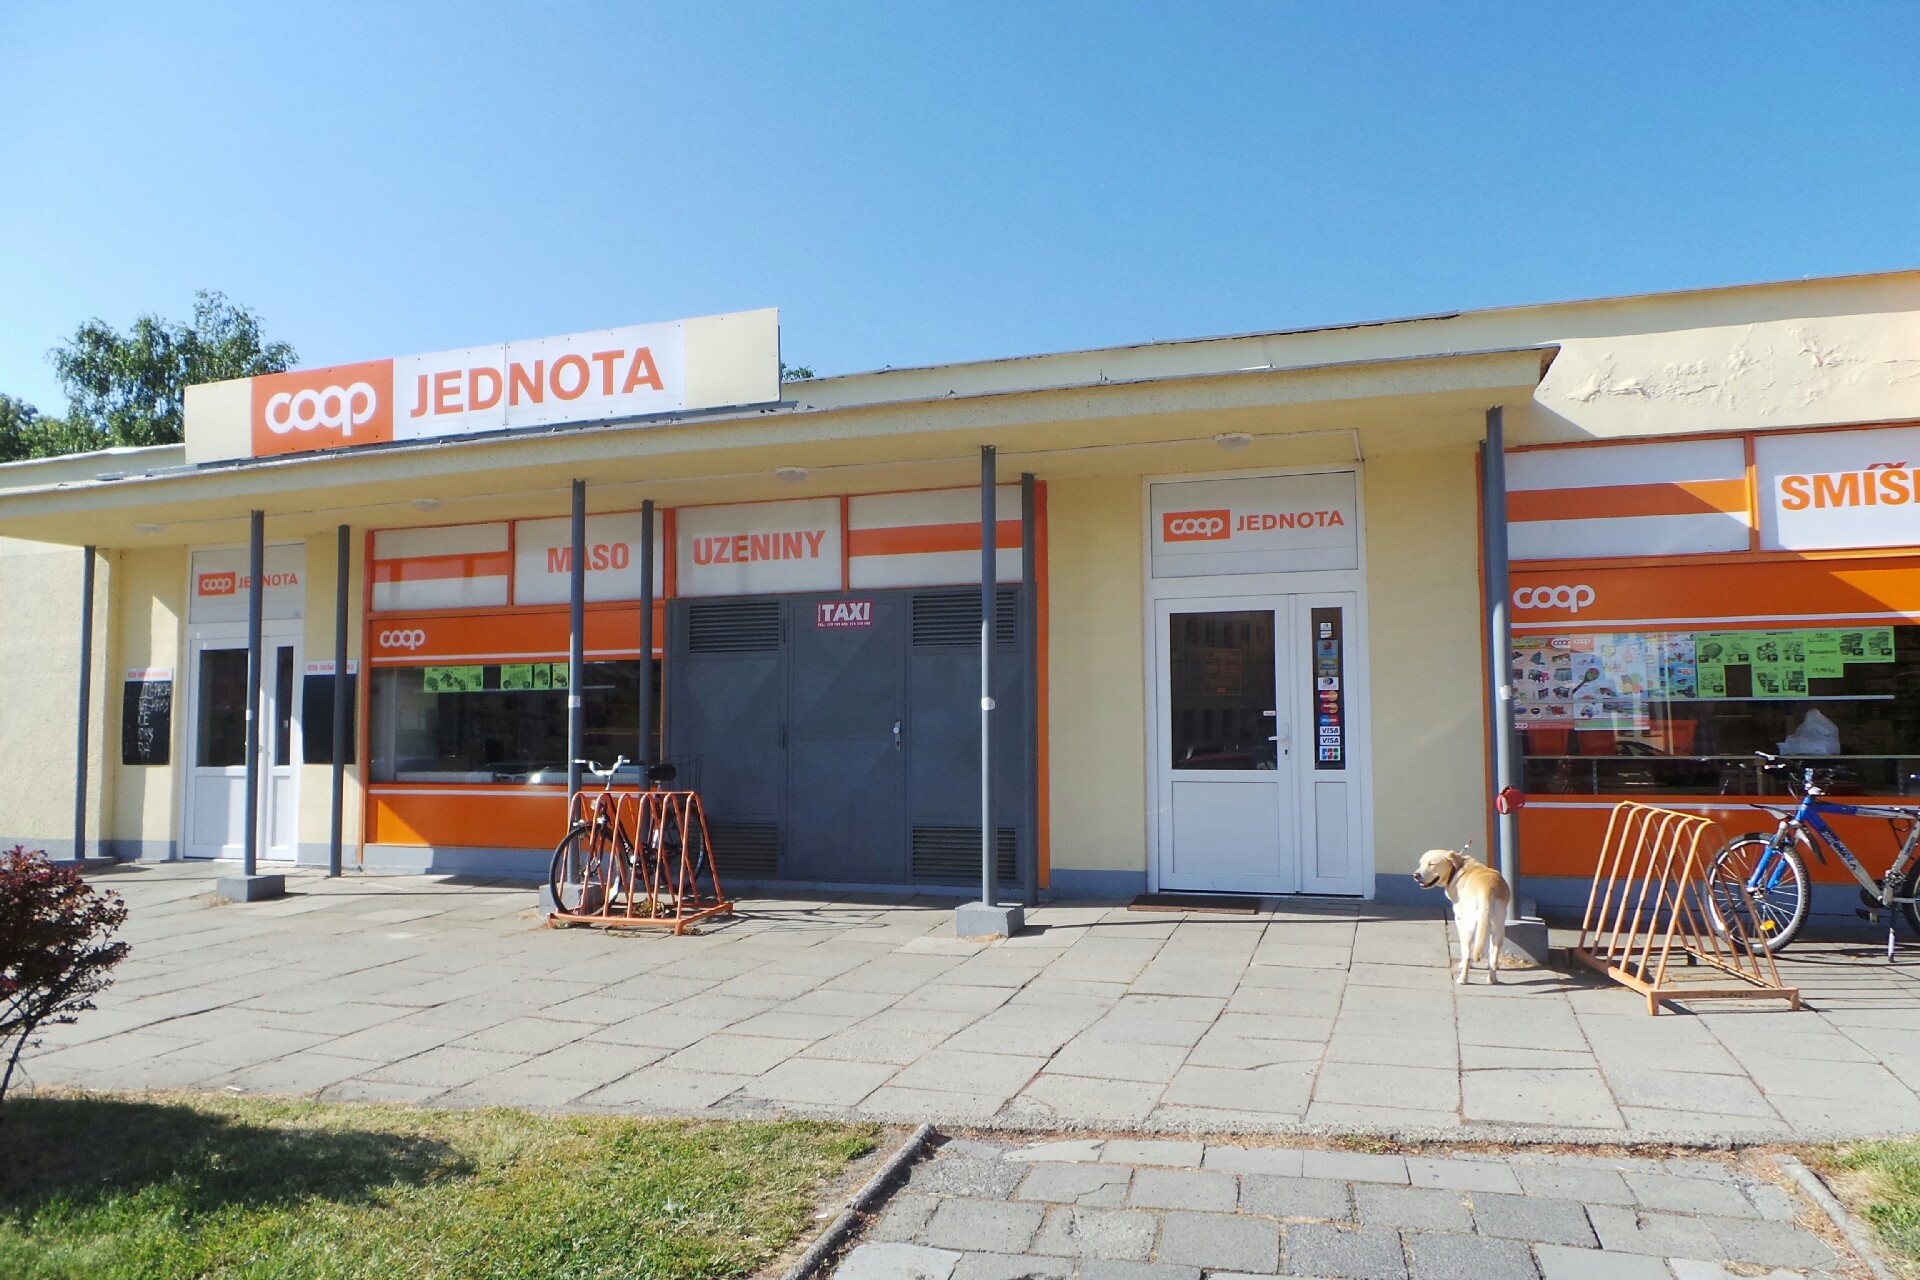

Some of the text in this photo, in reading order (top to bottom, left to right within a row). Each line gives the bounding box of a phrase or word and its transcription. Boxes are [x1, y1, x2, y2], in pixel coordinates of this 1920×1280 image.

[265, 346, 665, 437] coop JEDNOTA
[1781, 462, 1920, 511] SMÍŠ
[1170, 510, 1345, 537] coop JEDNOTA
[693, 530, 826, 565] UZENINY
[202, 573, 298, 592] coop JENOTA
[822, 603, 870, 621] TAXI
[1512, 584, 1596, 613] coop
[379, 629, 426, 650] coop
